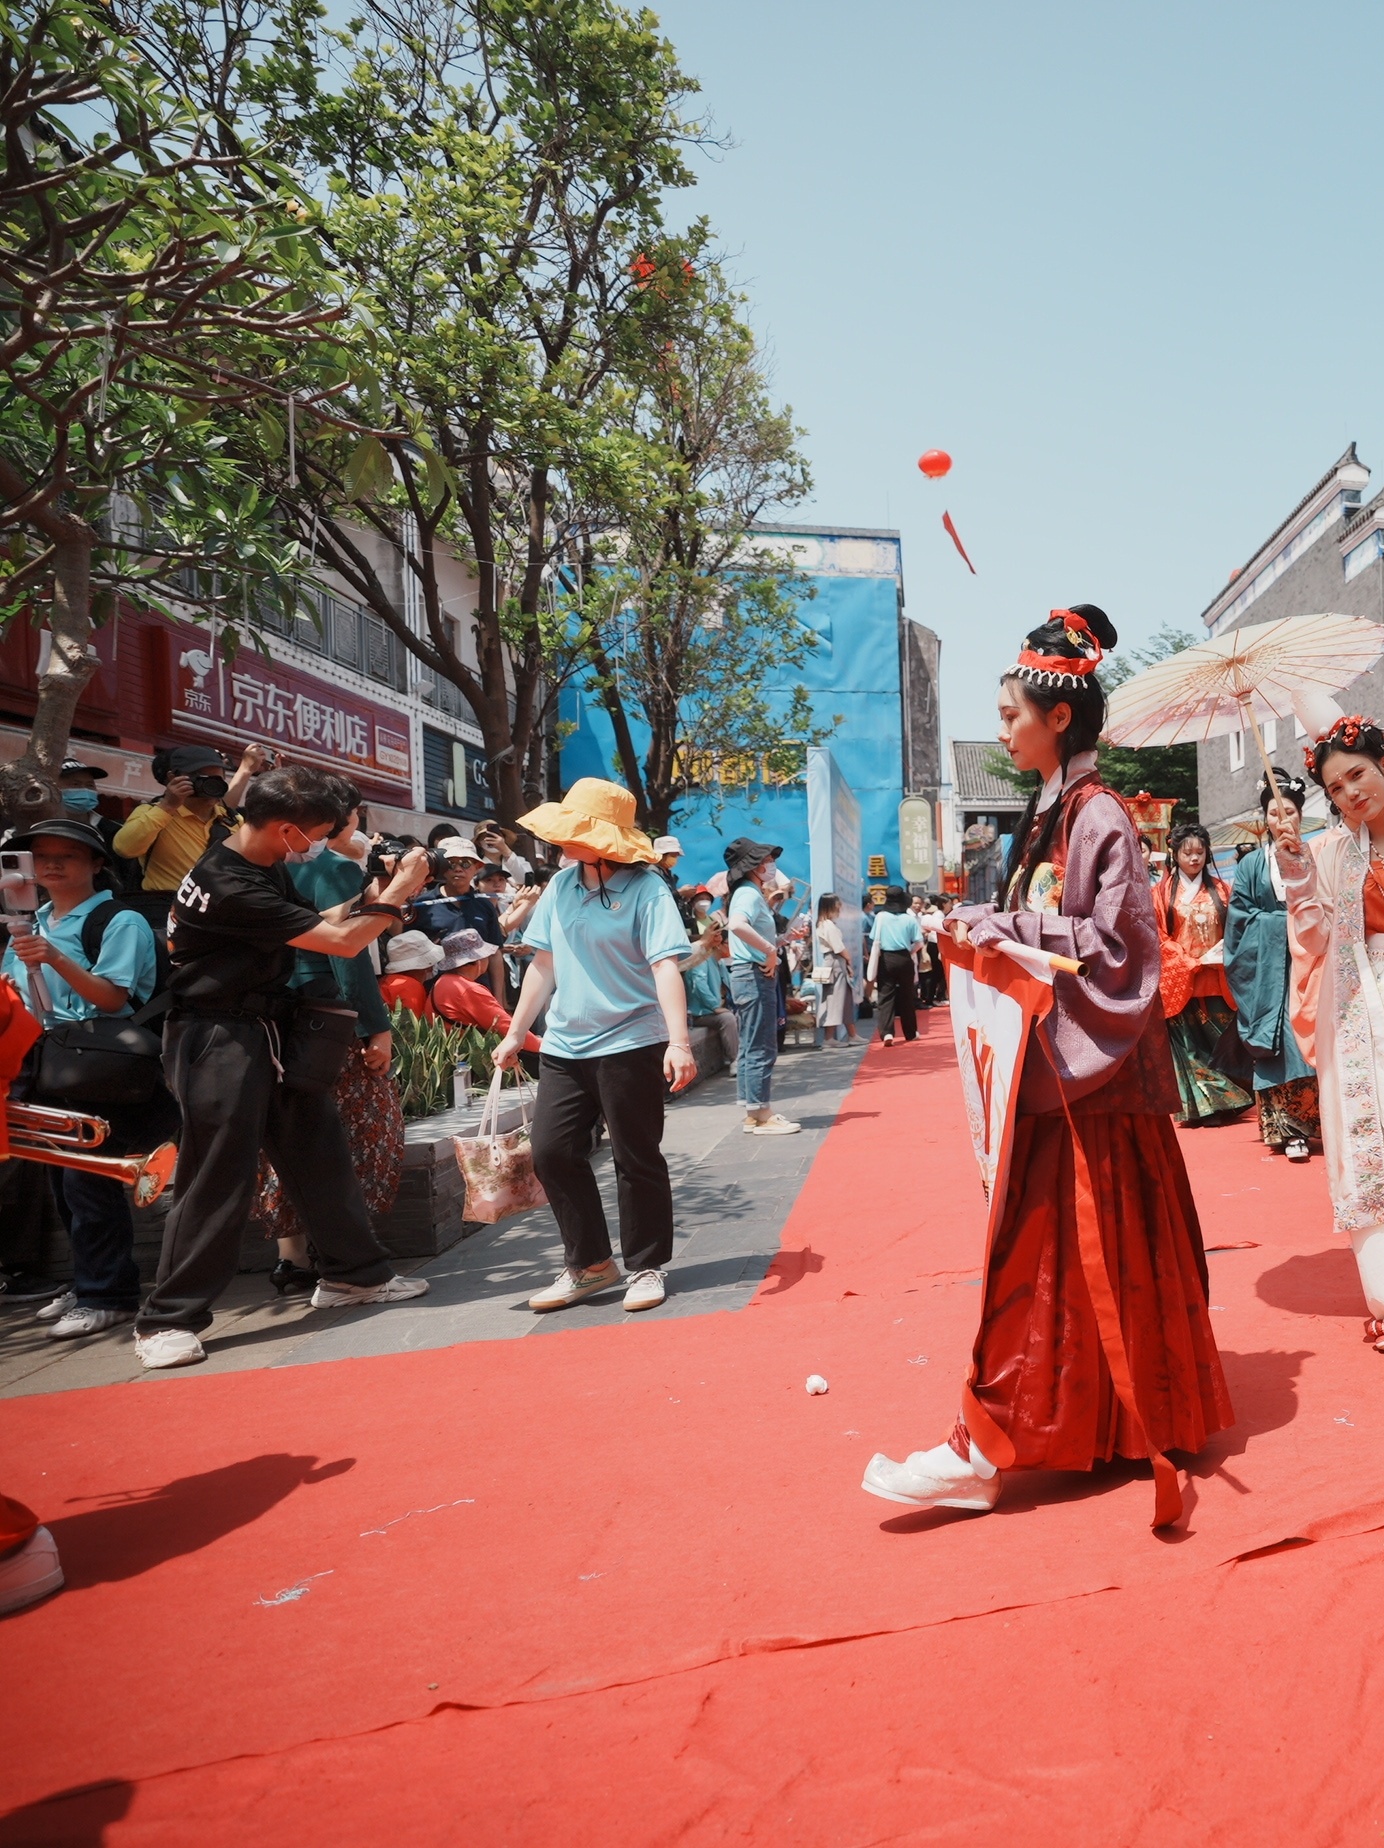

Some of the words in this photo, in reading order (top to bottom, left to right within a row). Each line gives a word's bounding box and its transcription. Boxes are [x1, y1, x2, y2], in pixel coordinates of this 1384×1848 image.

[184, 688, 213, 713] 京东
[231, 673, 369, 759] 京东便利店
[911, 816, 930, 865] 幸福里
